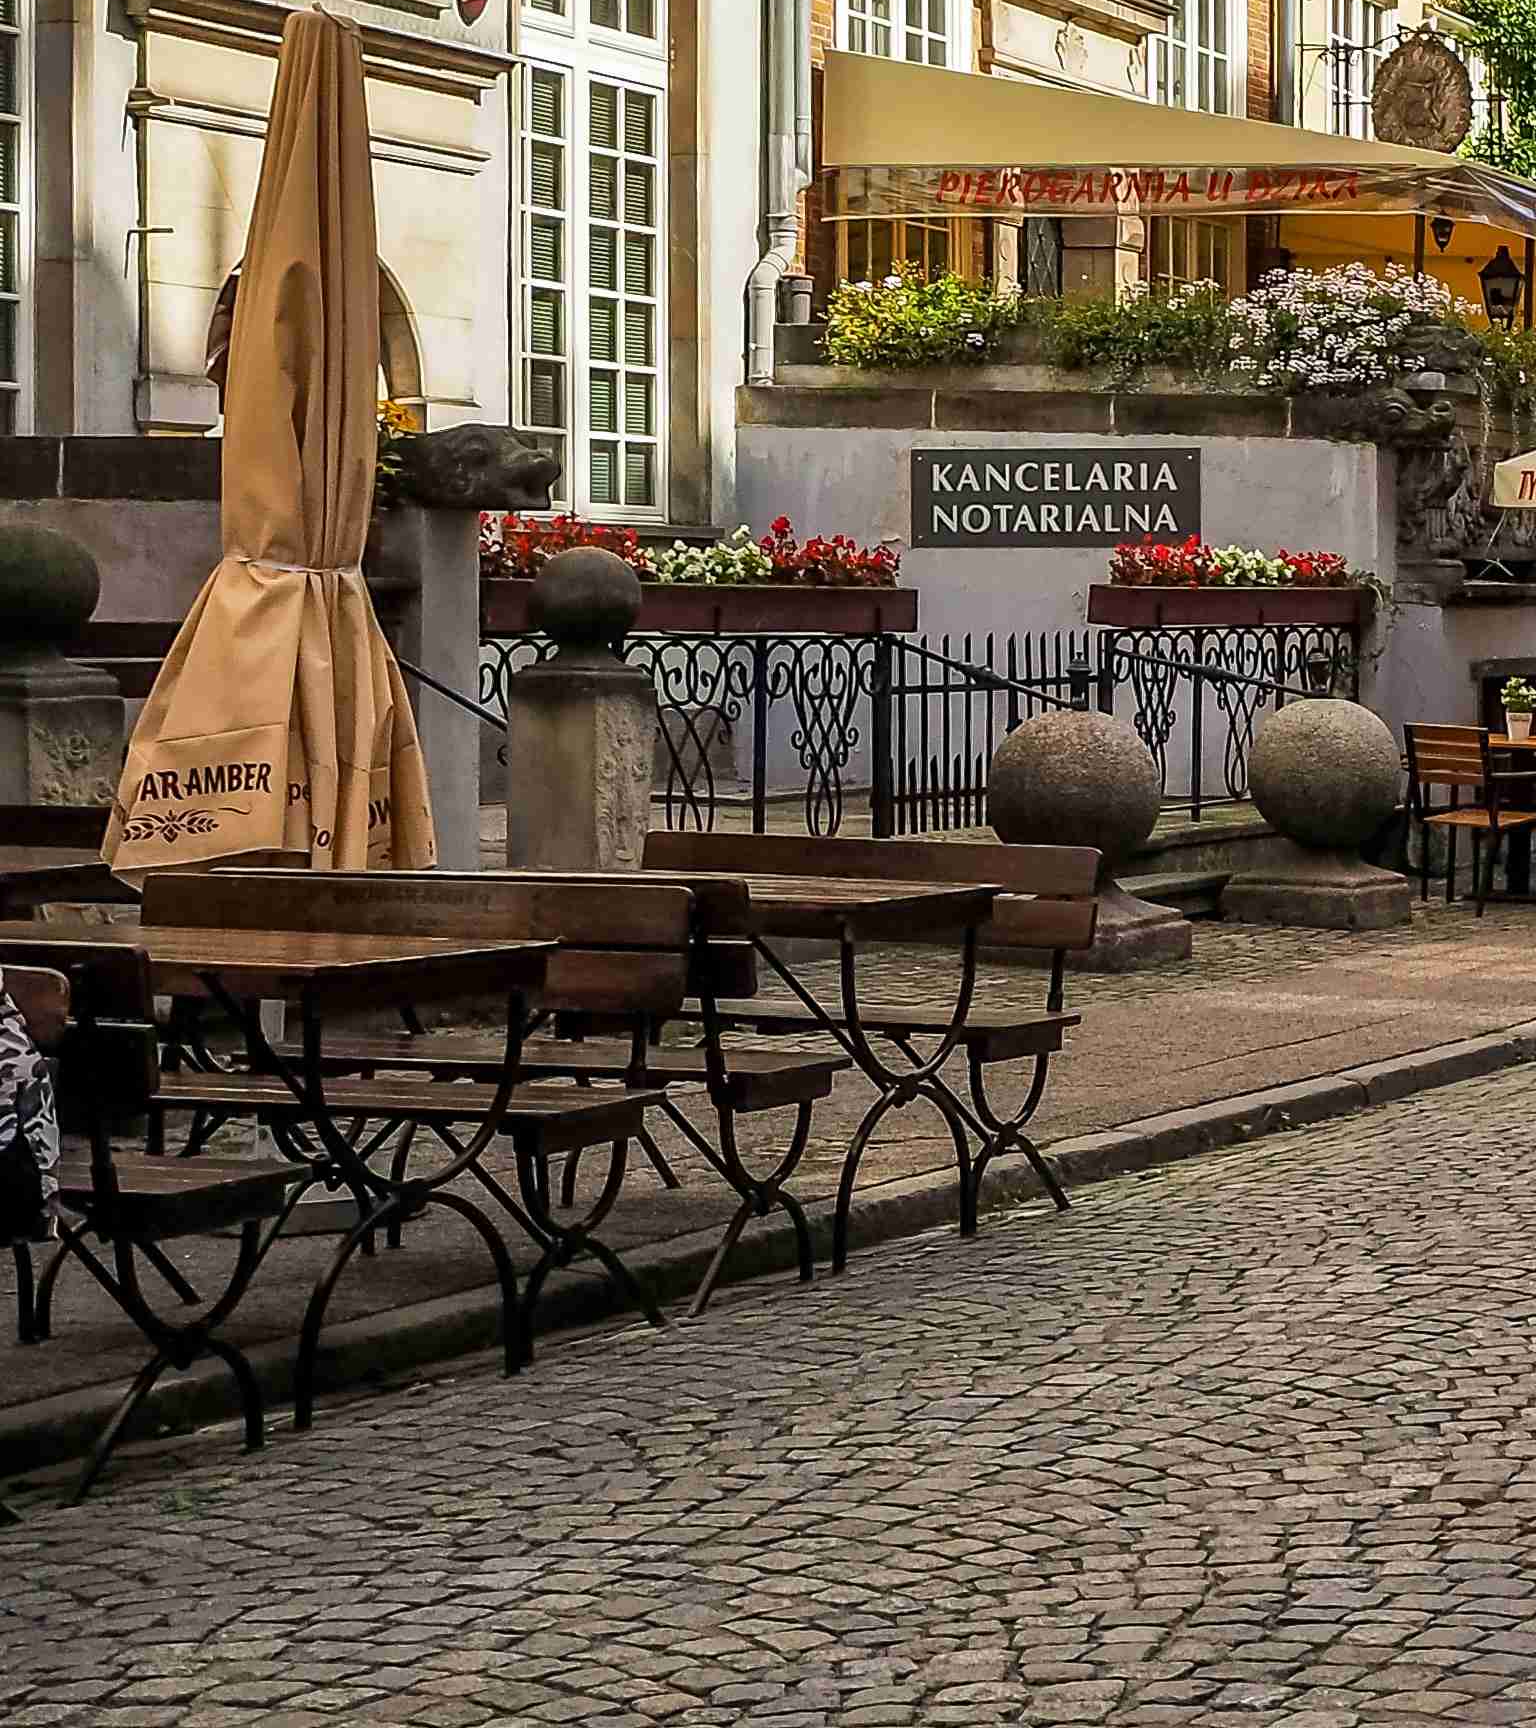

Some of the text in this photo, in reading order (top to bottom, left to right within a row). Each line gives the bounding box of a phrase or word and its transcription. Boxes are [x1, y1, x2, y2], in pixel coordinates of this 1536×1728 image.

[936, 170, 1189, 203] PIEROGARNIA
[1207, 171, 1233, 201] U
[931, 462, 1178, 492] KANCELARIA
[932, 503, 1178, 533] NOTARIALNA
